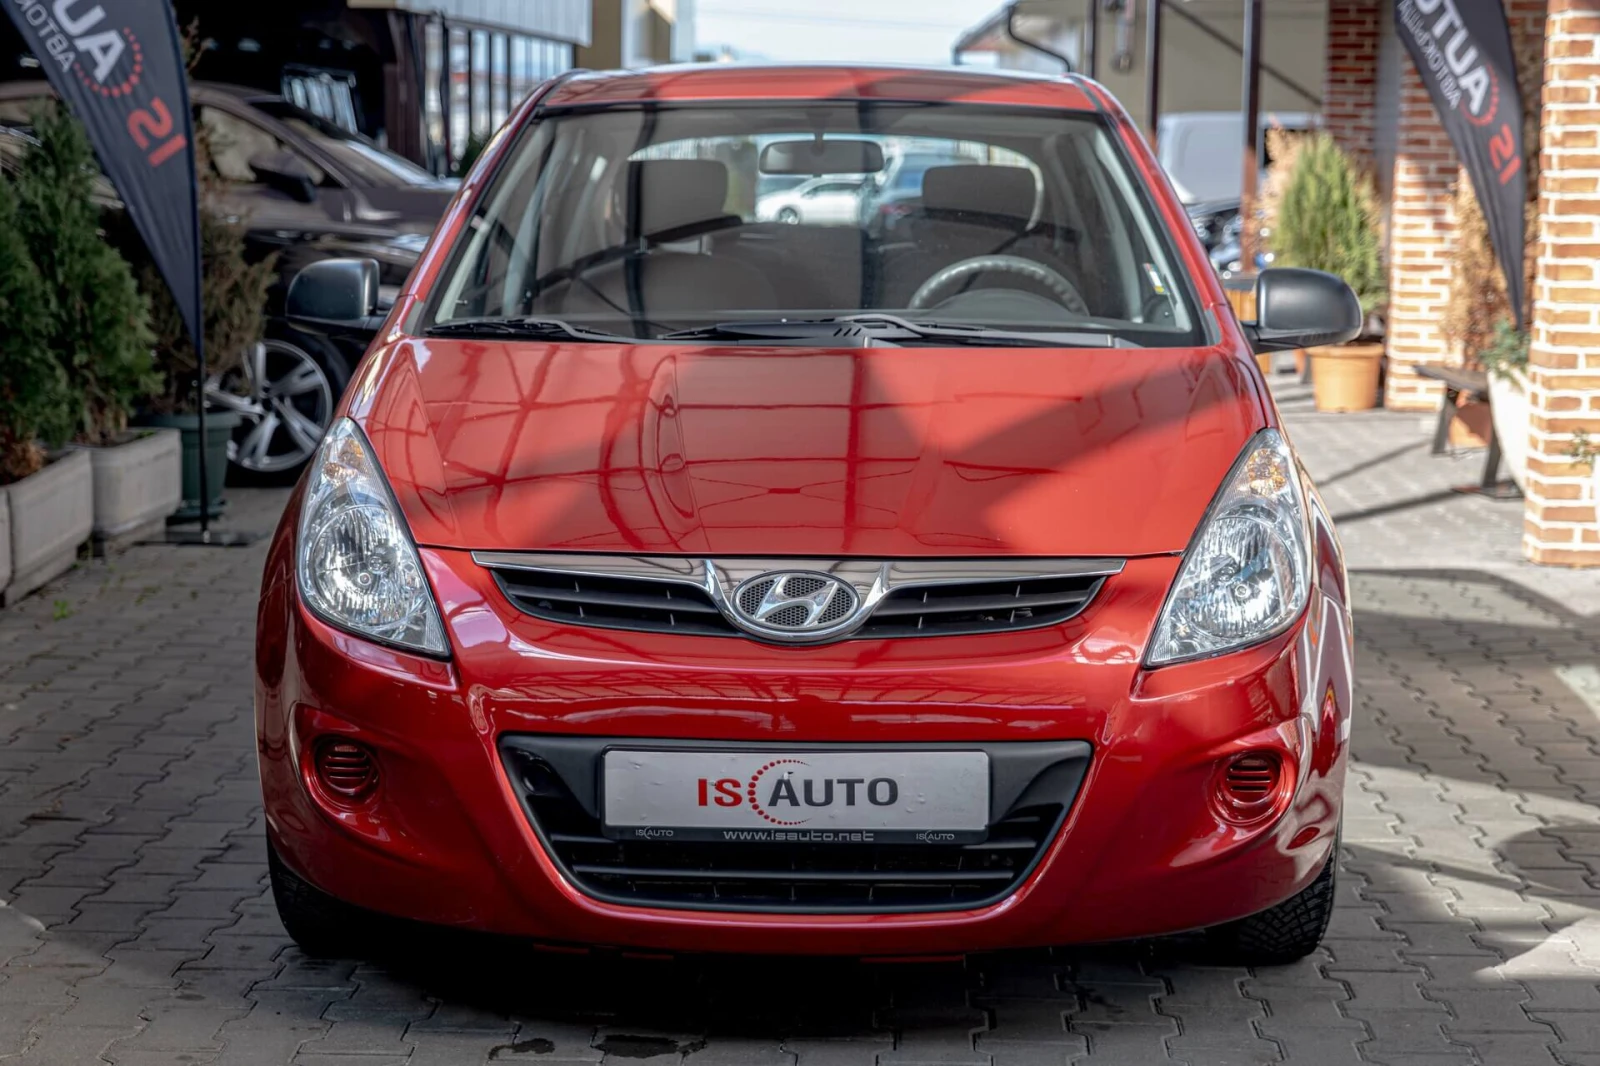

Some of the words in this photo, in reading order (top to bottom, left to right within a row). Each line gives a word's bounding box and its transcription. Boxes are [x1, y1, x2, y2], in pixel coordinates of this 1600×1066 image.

[697, 778, 743, 808] IS
[767, 777, 899, 808] AUTO
[723, 830, 875, 842] www.isauto.net
